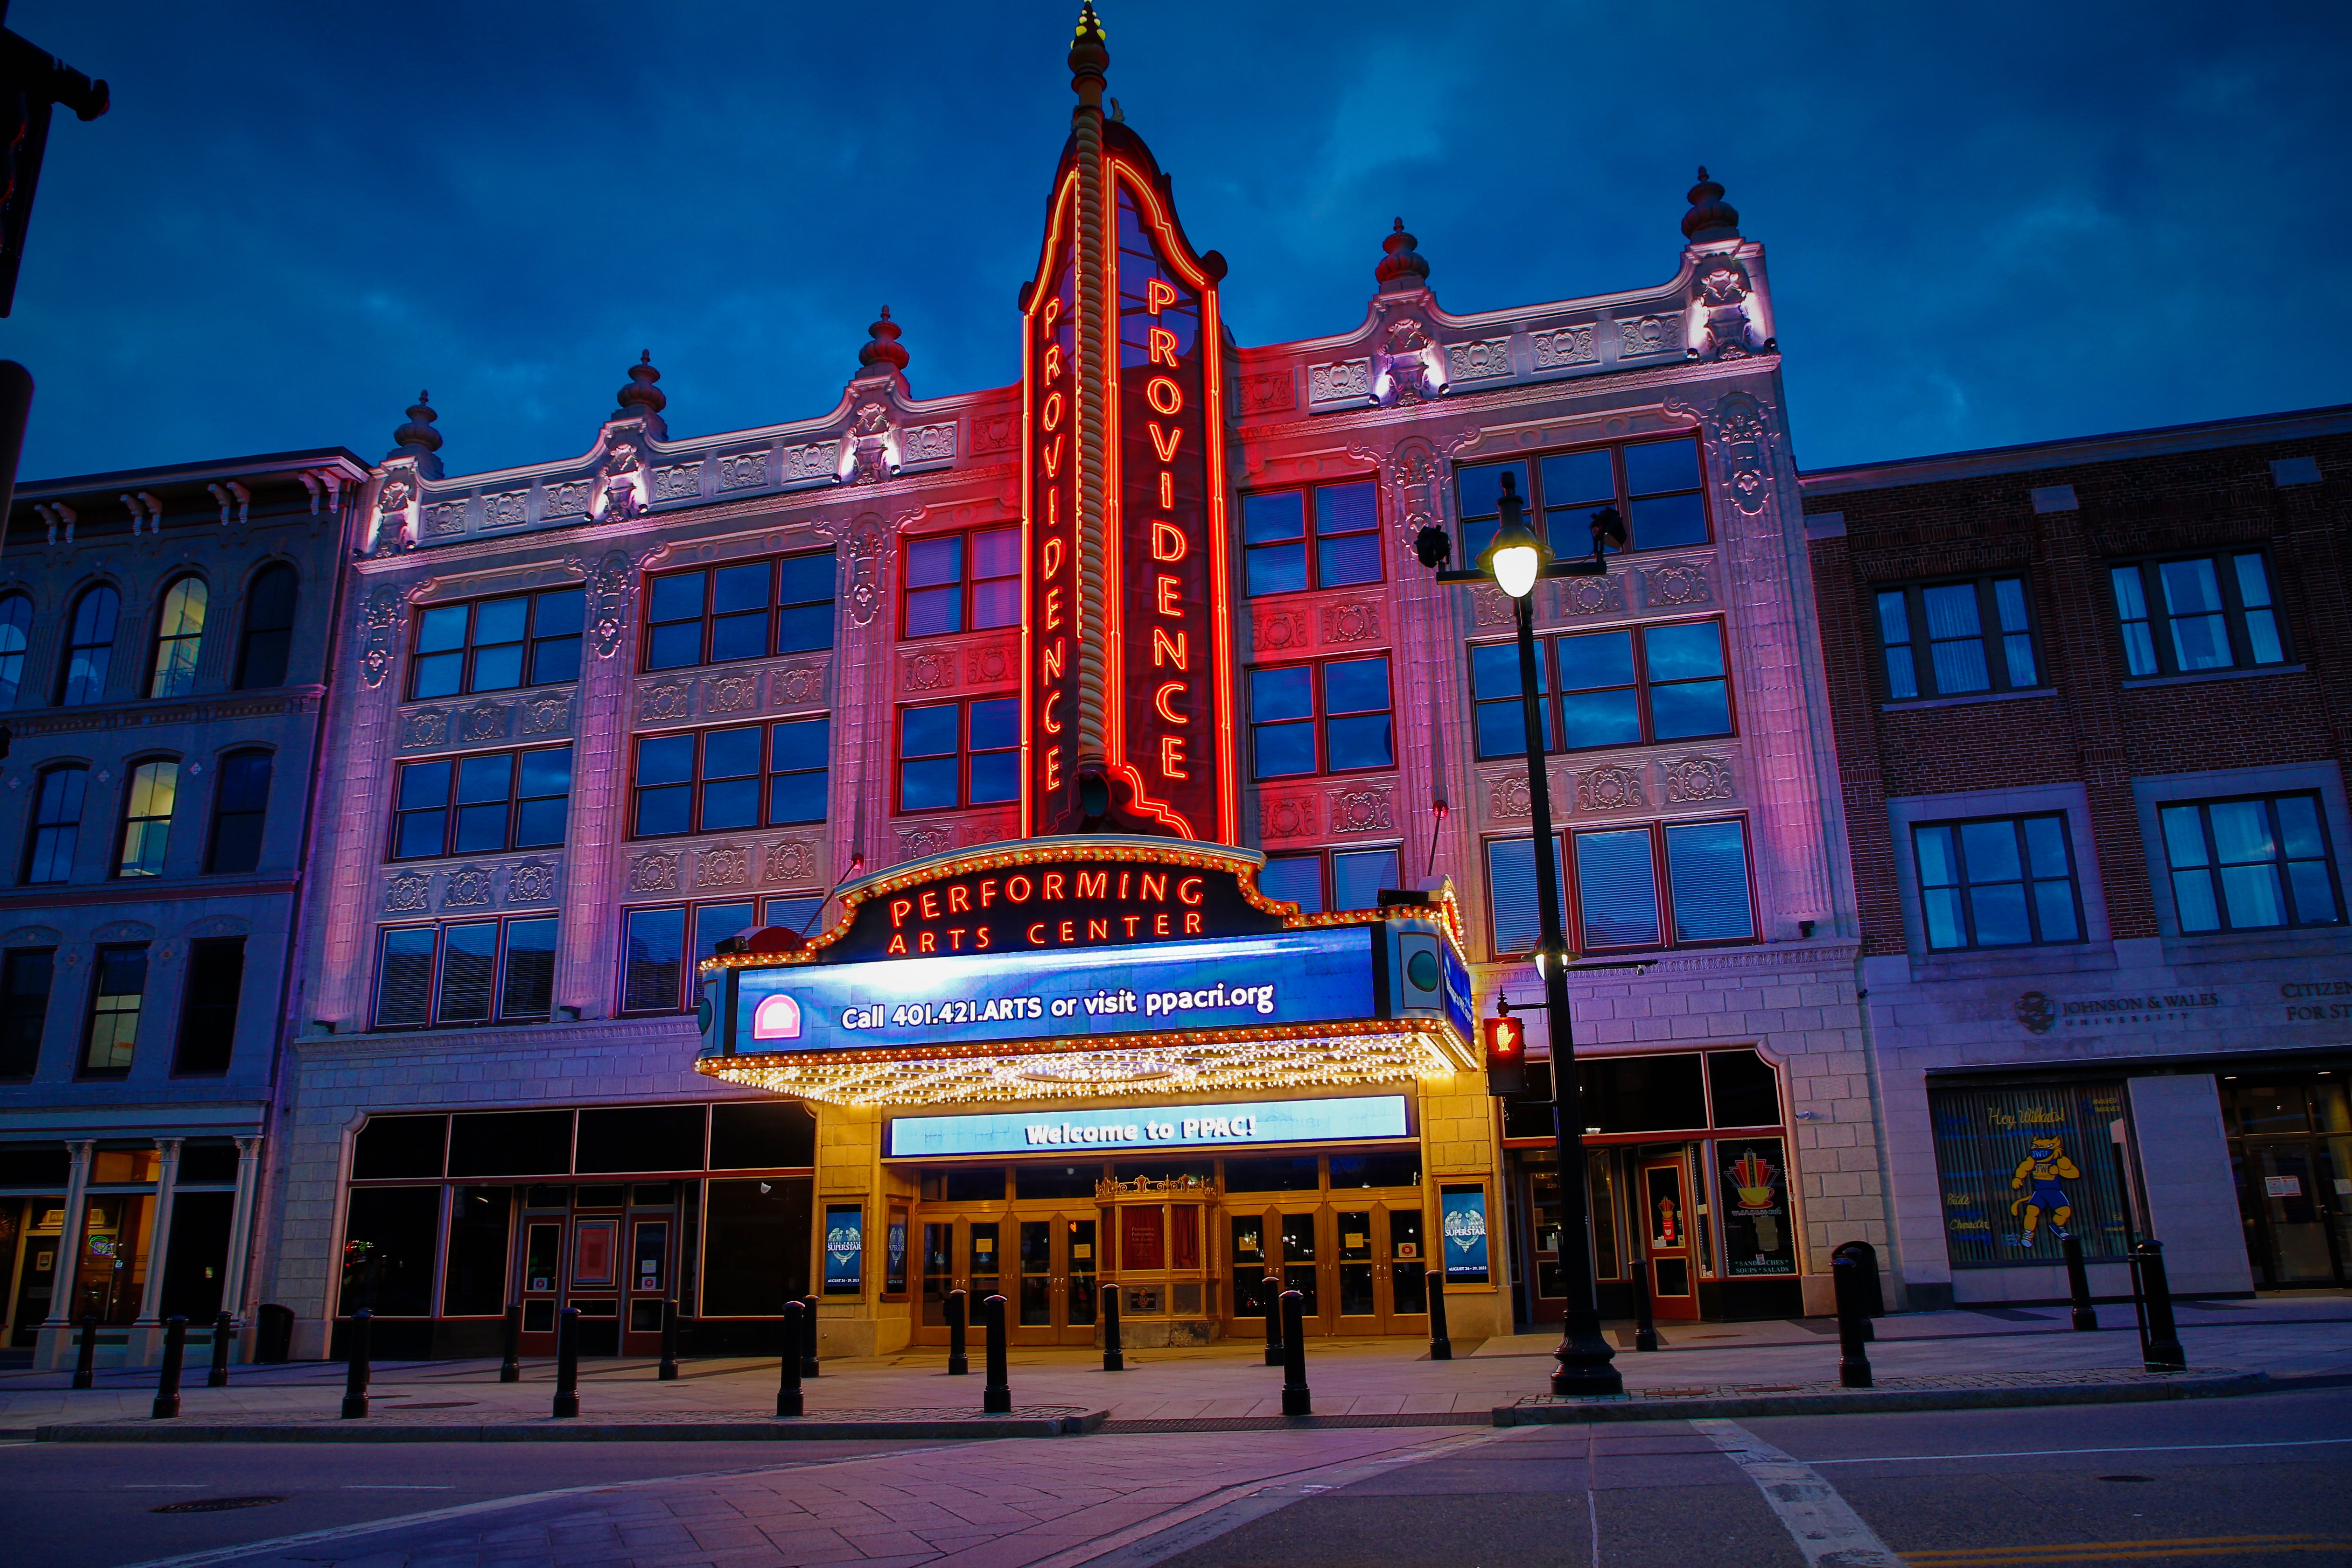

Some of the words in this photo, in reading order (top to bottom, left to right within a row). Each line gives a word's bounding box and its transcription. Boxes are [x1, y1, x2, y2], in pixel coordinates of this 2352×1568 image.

[1146, 277, 1190, 782] PROVIDENCE
[1042, 296, 1063, 793] PROVIDENCE
[889, 870, 1204, 928] PERFORMING
[887, 926, 990, 955] ARTS
[1027, 911, 1203, 944] CENTER
[841, 1004, 885, 1031] Call
[892, 996, 1043, 1028] 401.421.ARTS
[1051, 997, 1077, 1017] or
[1083, 990, 1137, 1015] visit
[1145, 982, 1275, 1017] ppacri.org
[2062, 997, 2142, 1016] JOHNSON
[2147, 996, 2161, 1009] &
[2163, 993, 2218, 1007] WALES
[2285, 1006, 2325, 1020] FOR
[2065, 1012, 2189, 1027] UNIVERSITY
[1025, 1123, 1138, 1145] Welcome
[1145, 1120, 1175, 1140] to
[1181, 1115, 1257, 1139] PPAC!
[1987, 1107, 2017, 1130] Hey
[1947, 1193, 1971, 1205] Pride
[1445, 1228, 1486, 1236] SUPERSTAR
[827, 1243, 862, 1252] SUPERSTAR
